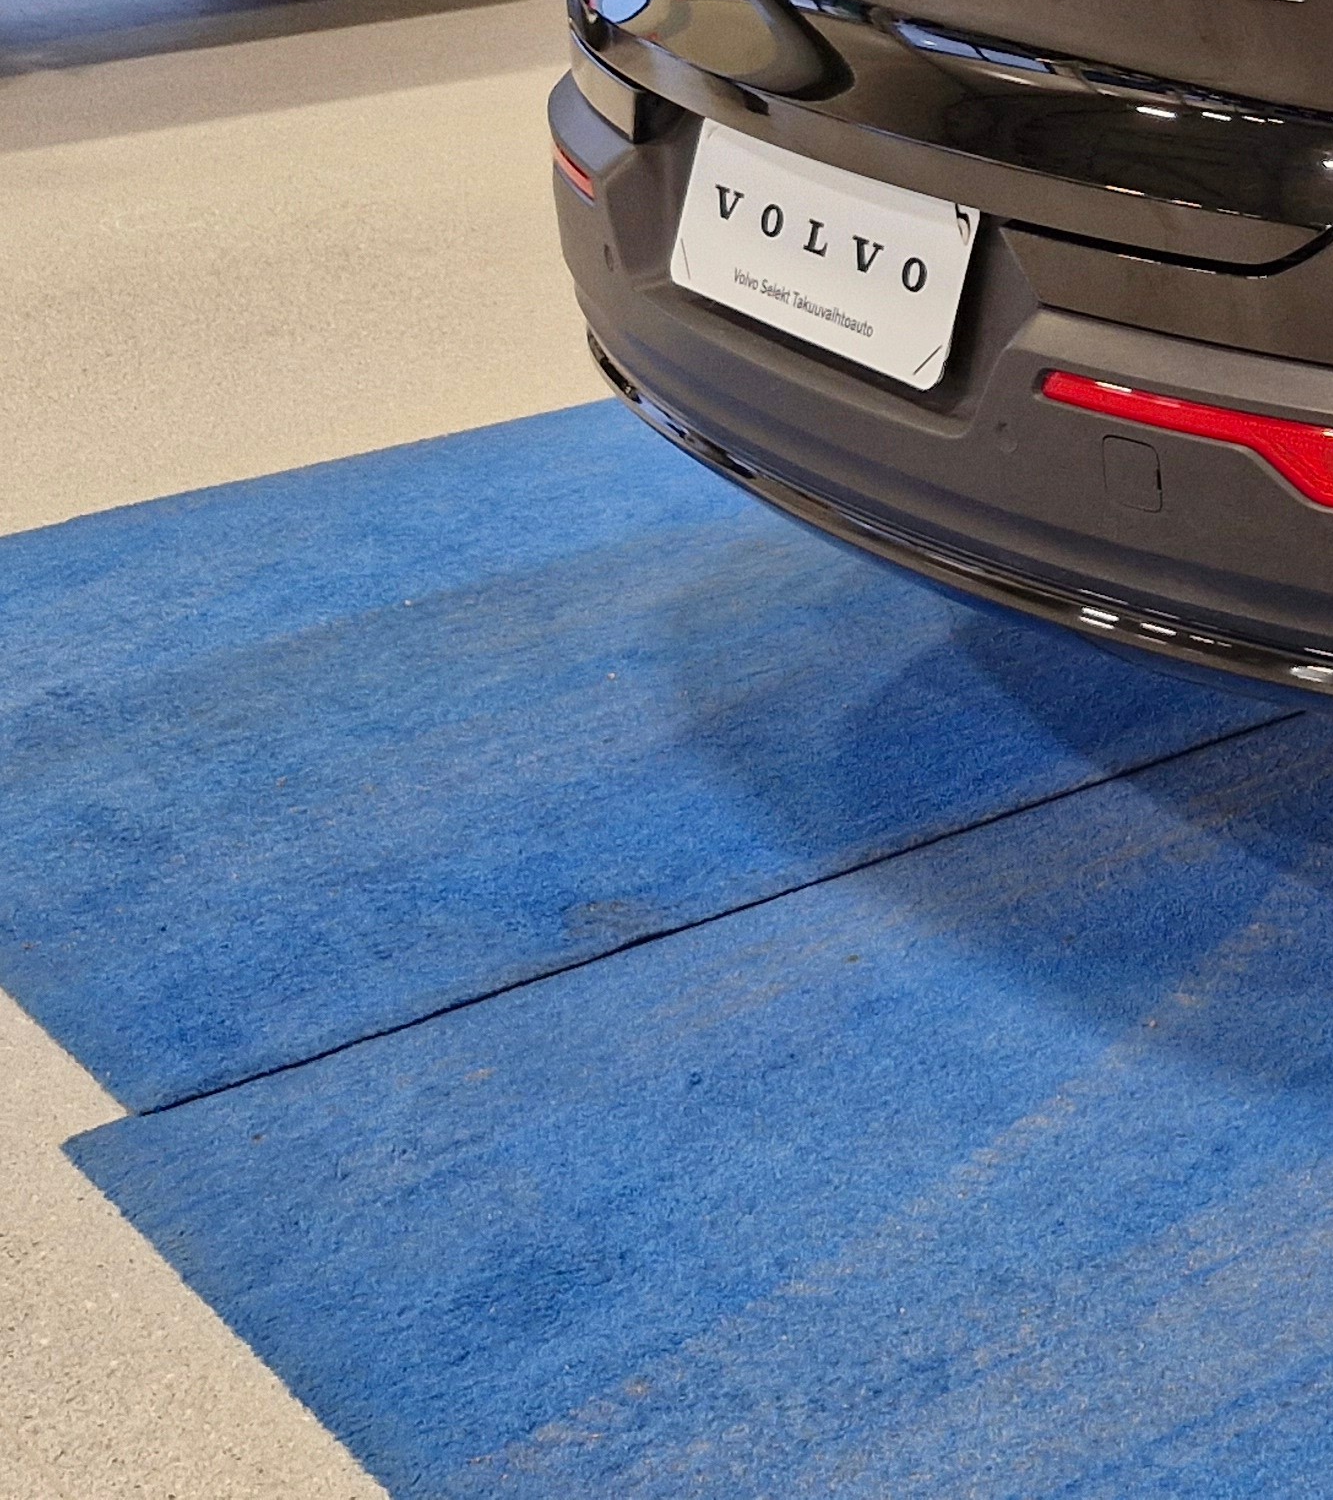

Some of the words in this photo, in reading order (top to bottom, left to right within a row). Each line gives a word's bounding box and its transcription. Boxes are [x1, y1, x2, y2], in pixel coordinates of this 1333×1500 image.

[715, 184, 928, 293] VOLVO
[734, 267, 759, 291] Volvo
[759, 278, 791, 305] Selekt
